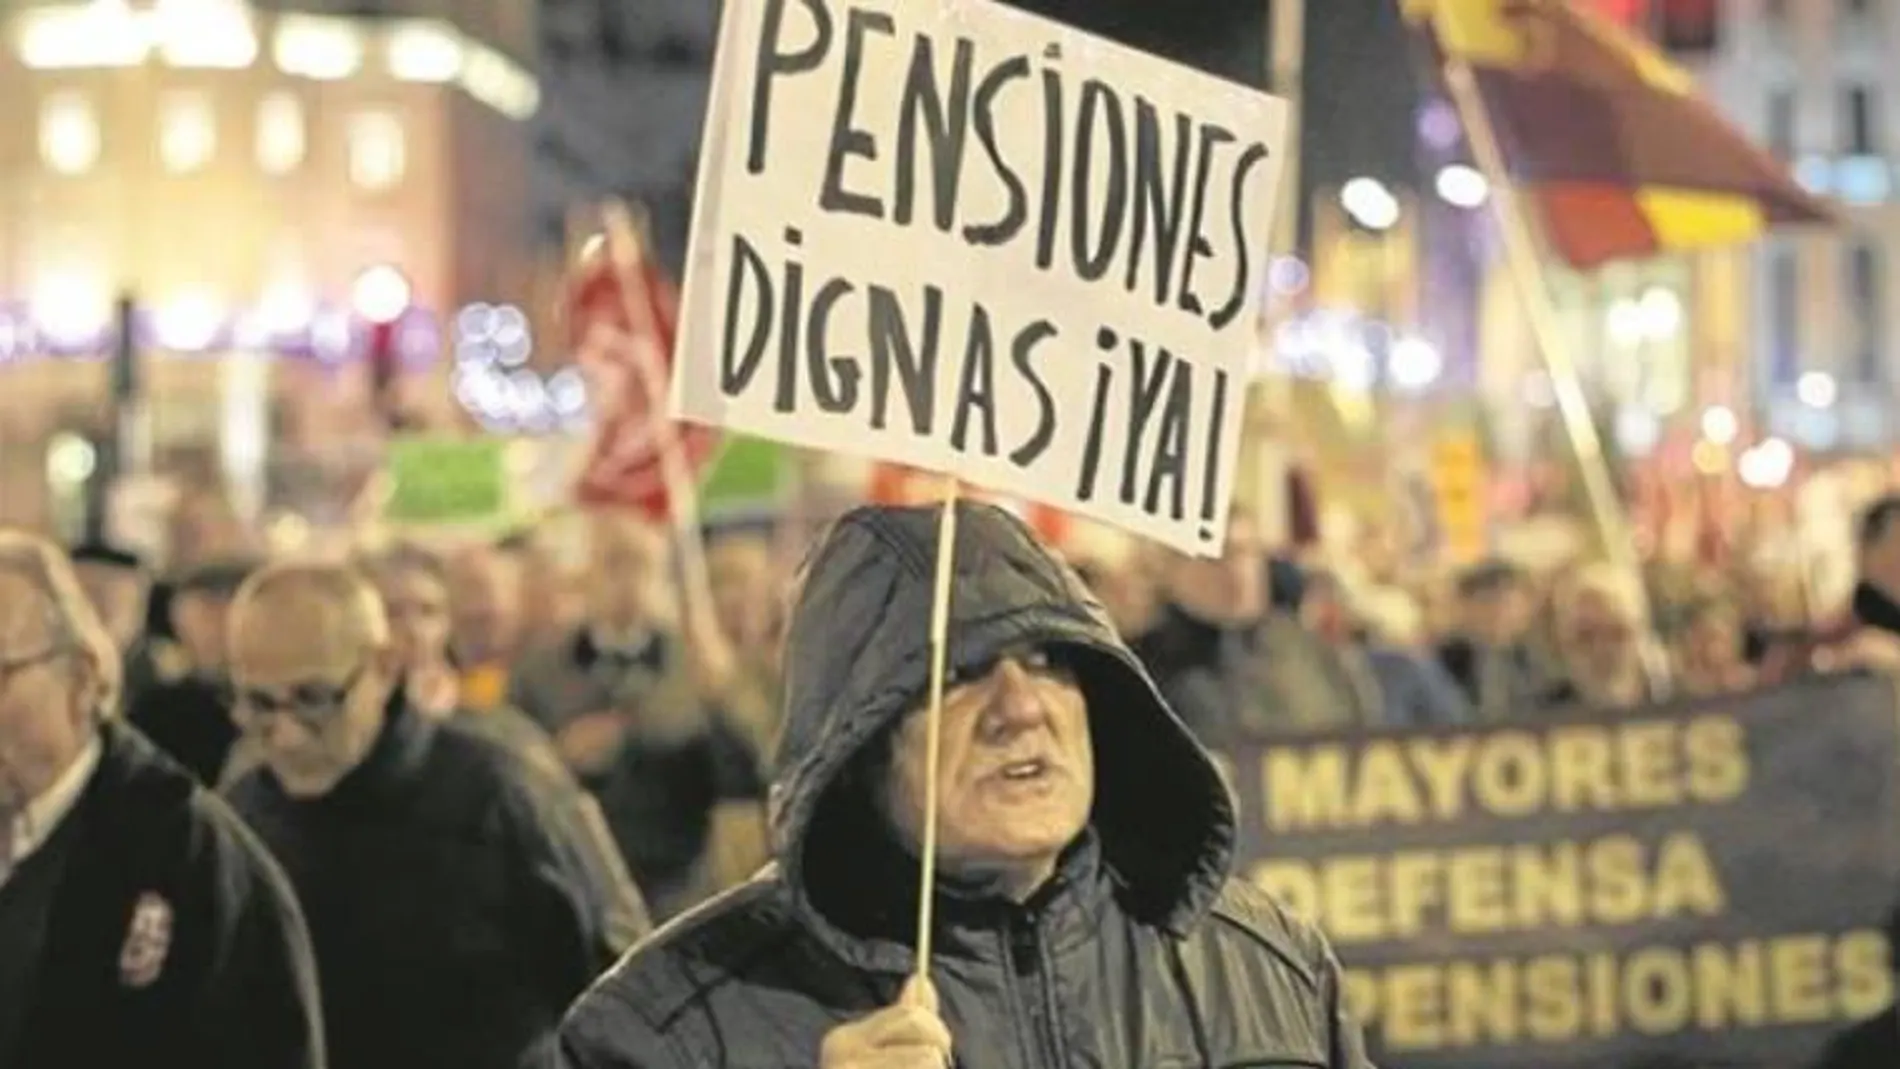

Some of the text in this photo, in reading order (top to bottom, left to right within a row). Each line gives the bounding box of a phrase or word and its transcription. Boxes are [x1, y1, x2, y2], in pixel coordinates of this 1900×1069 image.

[747, 0, 1268, 330] PENSIONES
[721, 226, 1227, 540] DIGNAS ¡YA!
[1262, 715, 1748, 832] MAYORES
